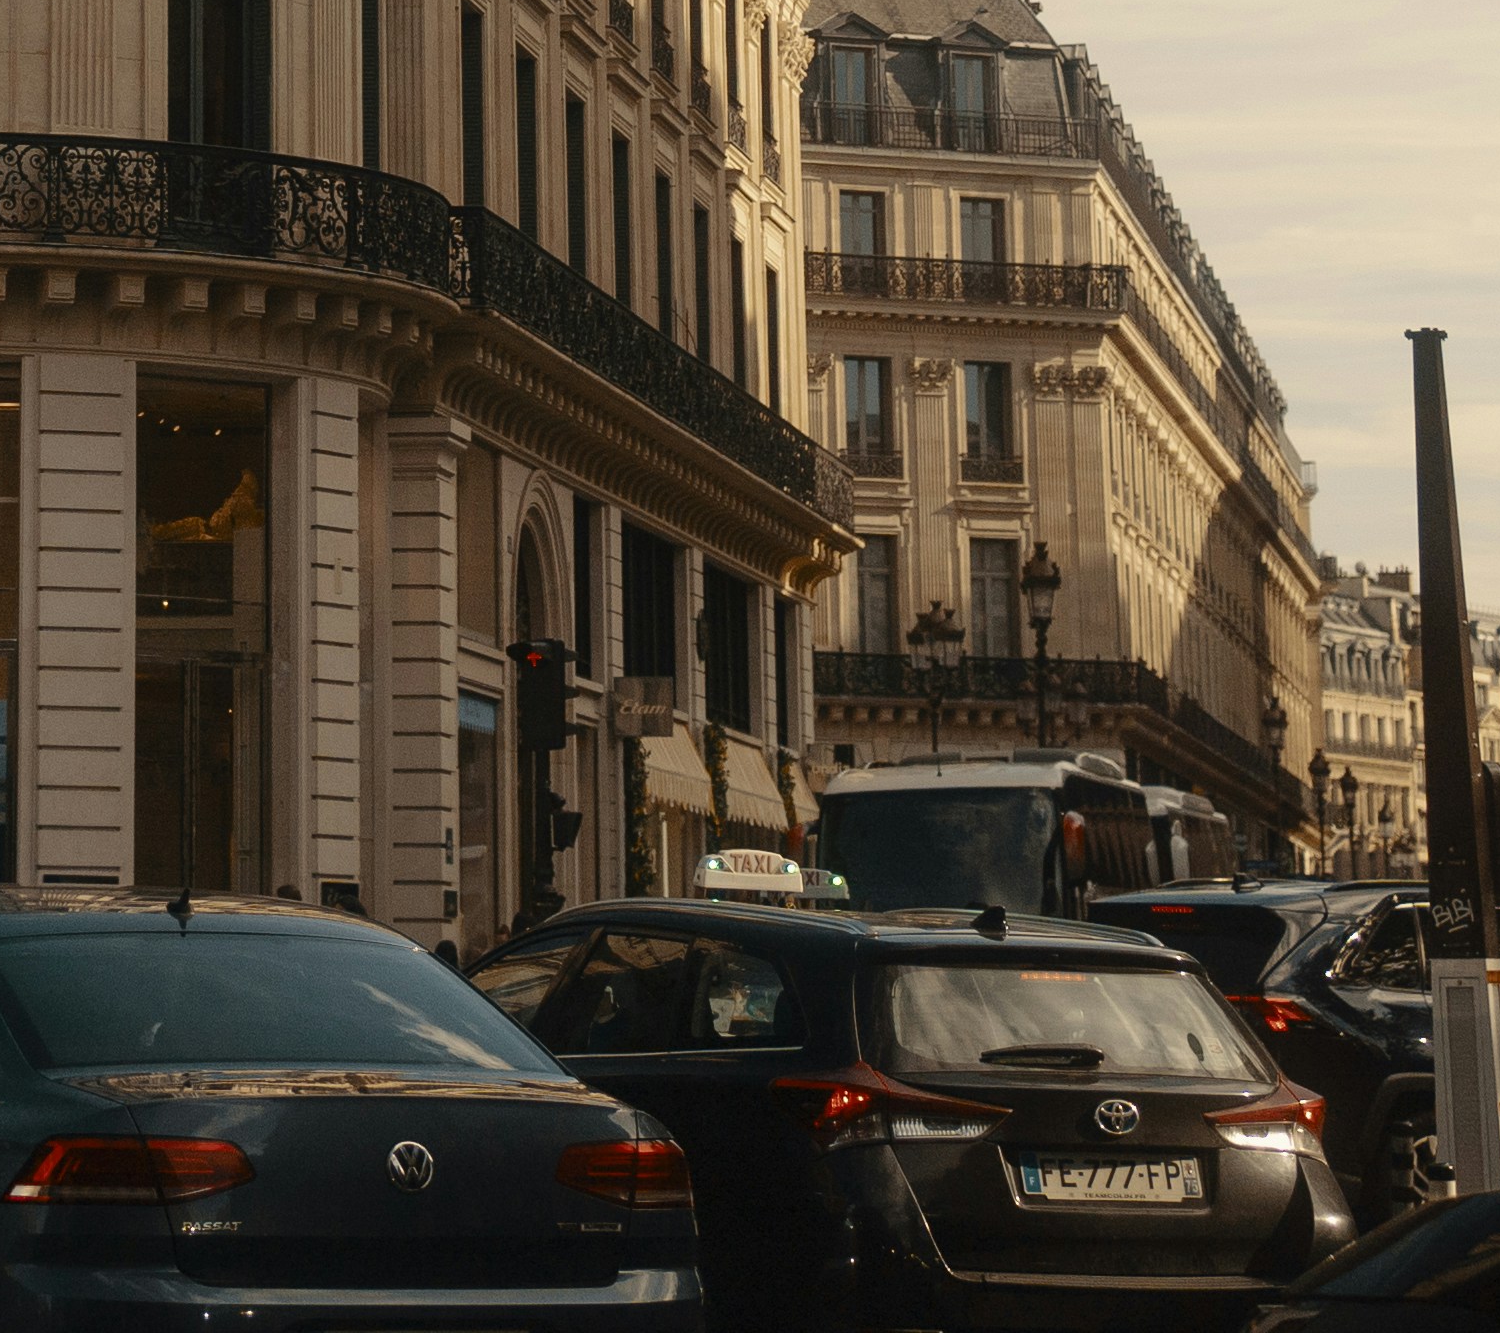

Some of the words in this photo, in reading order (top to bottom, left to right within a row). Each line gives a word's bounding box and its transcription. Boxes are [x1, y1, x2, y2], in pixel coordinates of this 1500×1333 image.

[619, 698, 667, 715] Etam
[730, 853, 772, 874] TAXI
[804, 870, 821, 886] XI
[1028, 1176, 1036, 1186] F
[1185, 1179, 1199, 1193] 75
[181, 1220, 243, 1232] PASSAT
